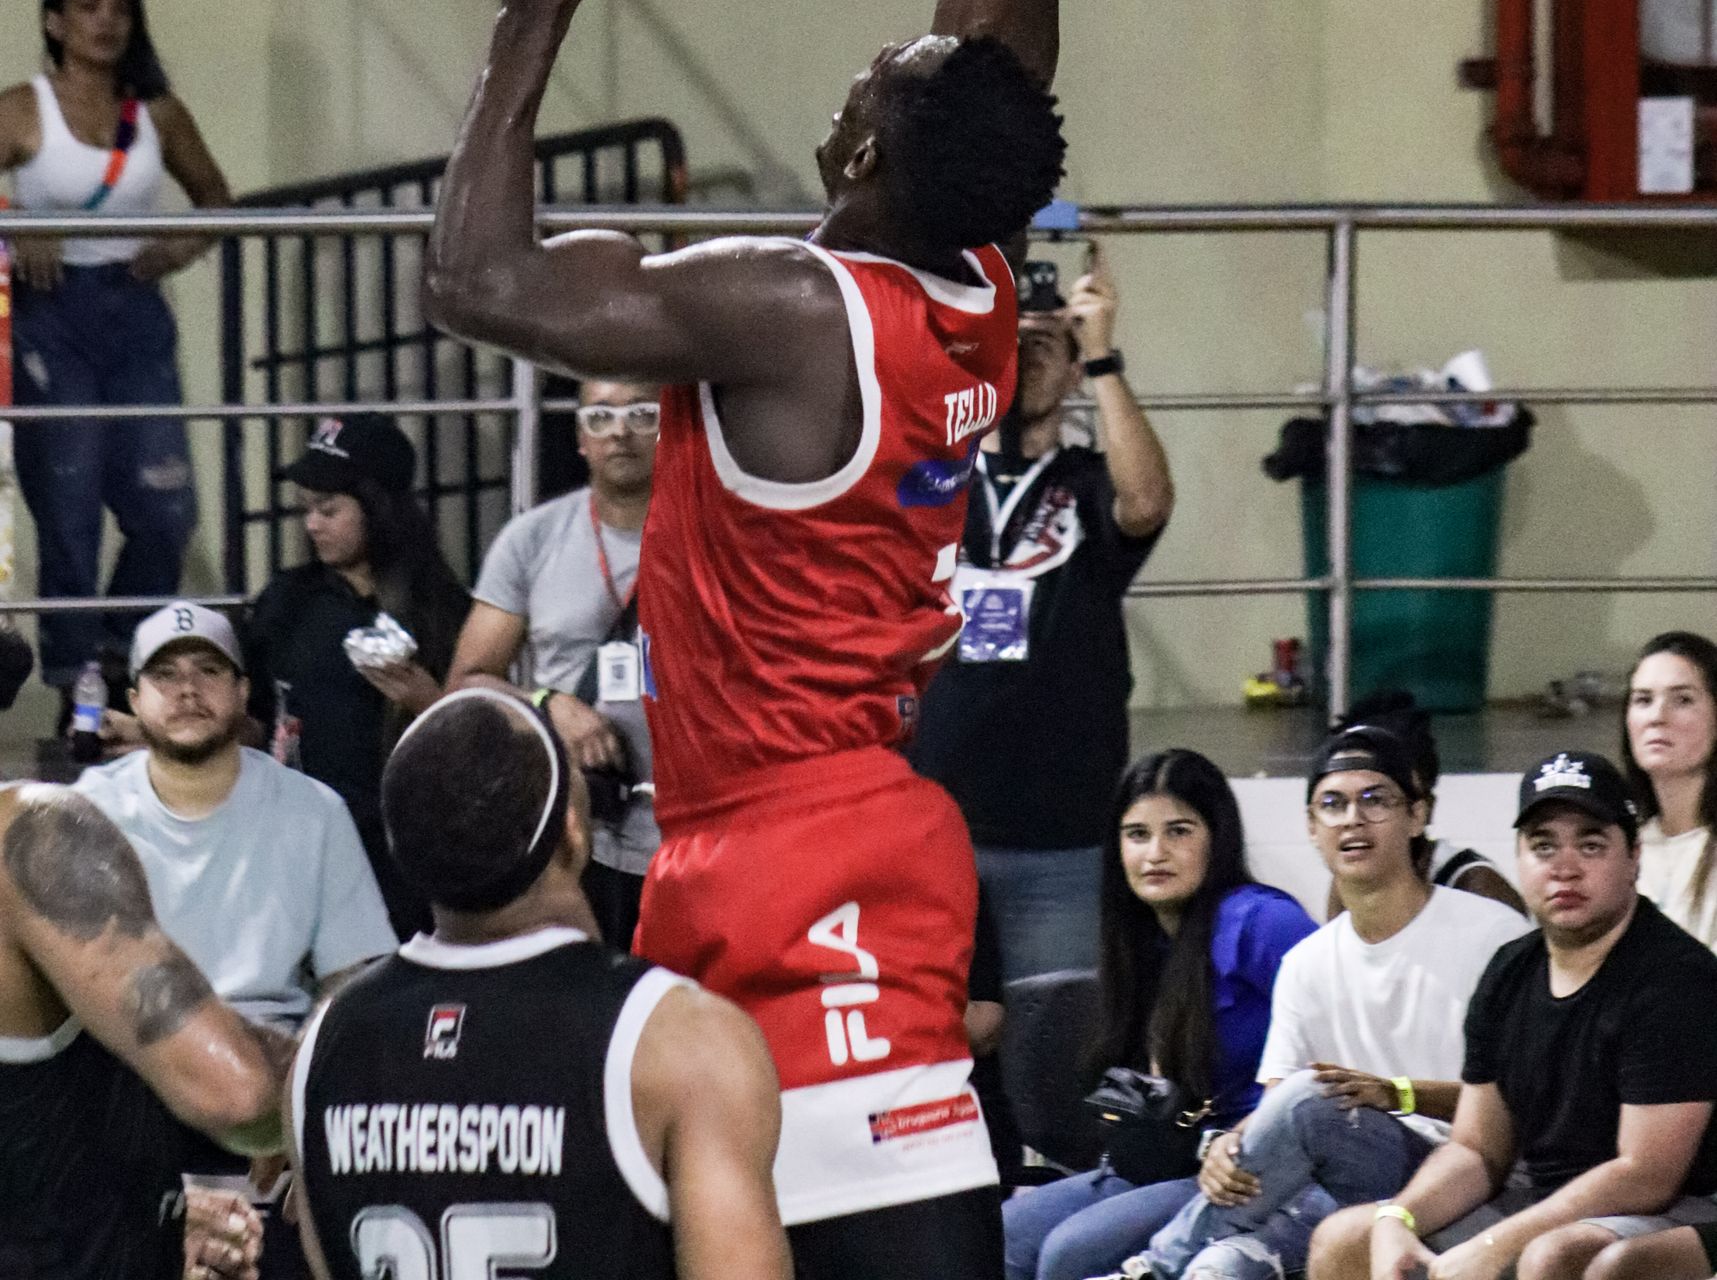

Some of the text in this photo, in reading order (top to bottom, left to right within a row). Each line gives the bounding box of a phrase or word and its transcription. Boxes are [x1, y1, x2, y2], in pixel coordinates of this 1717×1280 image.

[944, 381, 997, 446] TELLO
[171, 607, 195, 632] B
[324, 1103, 565, 1176] WEATHERSPOON
